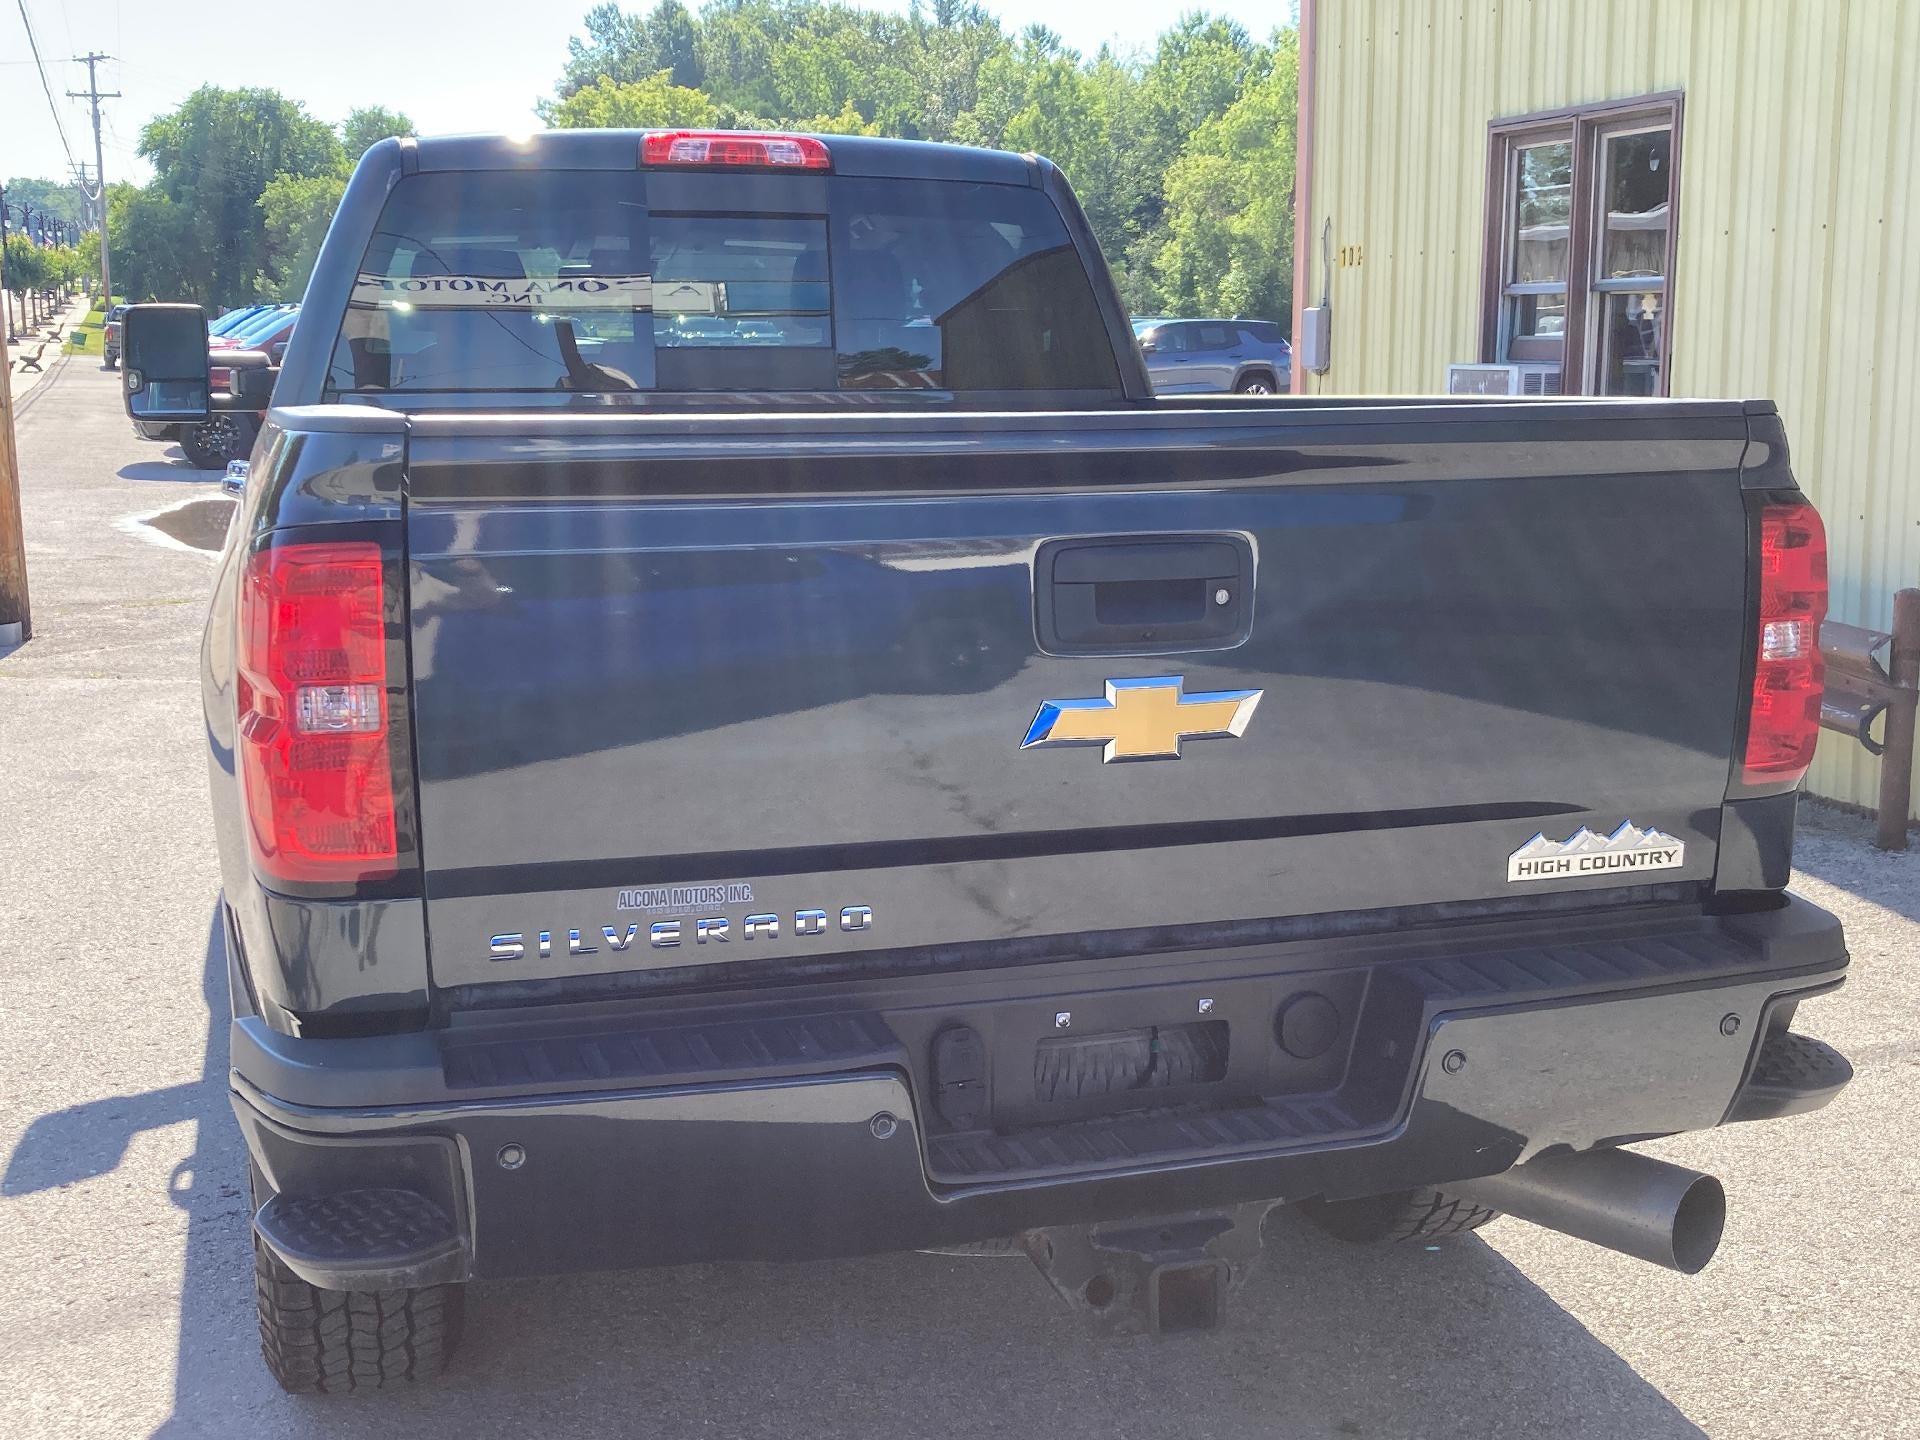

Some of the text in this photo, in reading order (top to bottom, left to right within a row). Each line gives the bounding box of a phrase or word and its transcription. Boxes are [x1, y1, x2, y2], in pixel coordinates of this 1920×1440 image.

[1517, 849, 1678, 876] HIGH COUNTRY
[617, 882, 755, 909] ALCONA MOTORS INC.
[488, 904, 874, 961] SILVERADO
